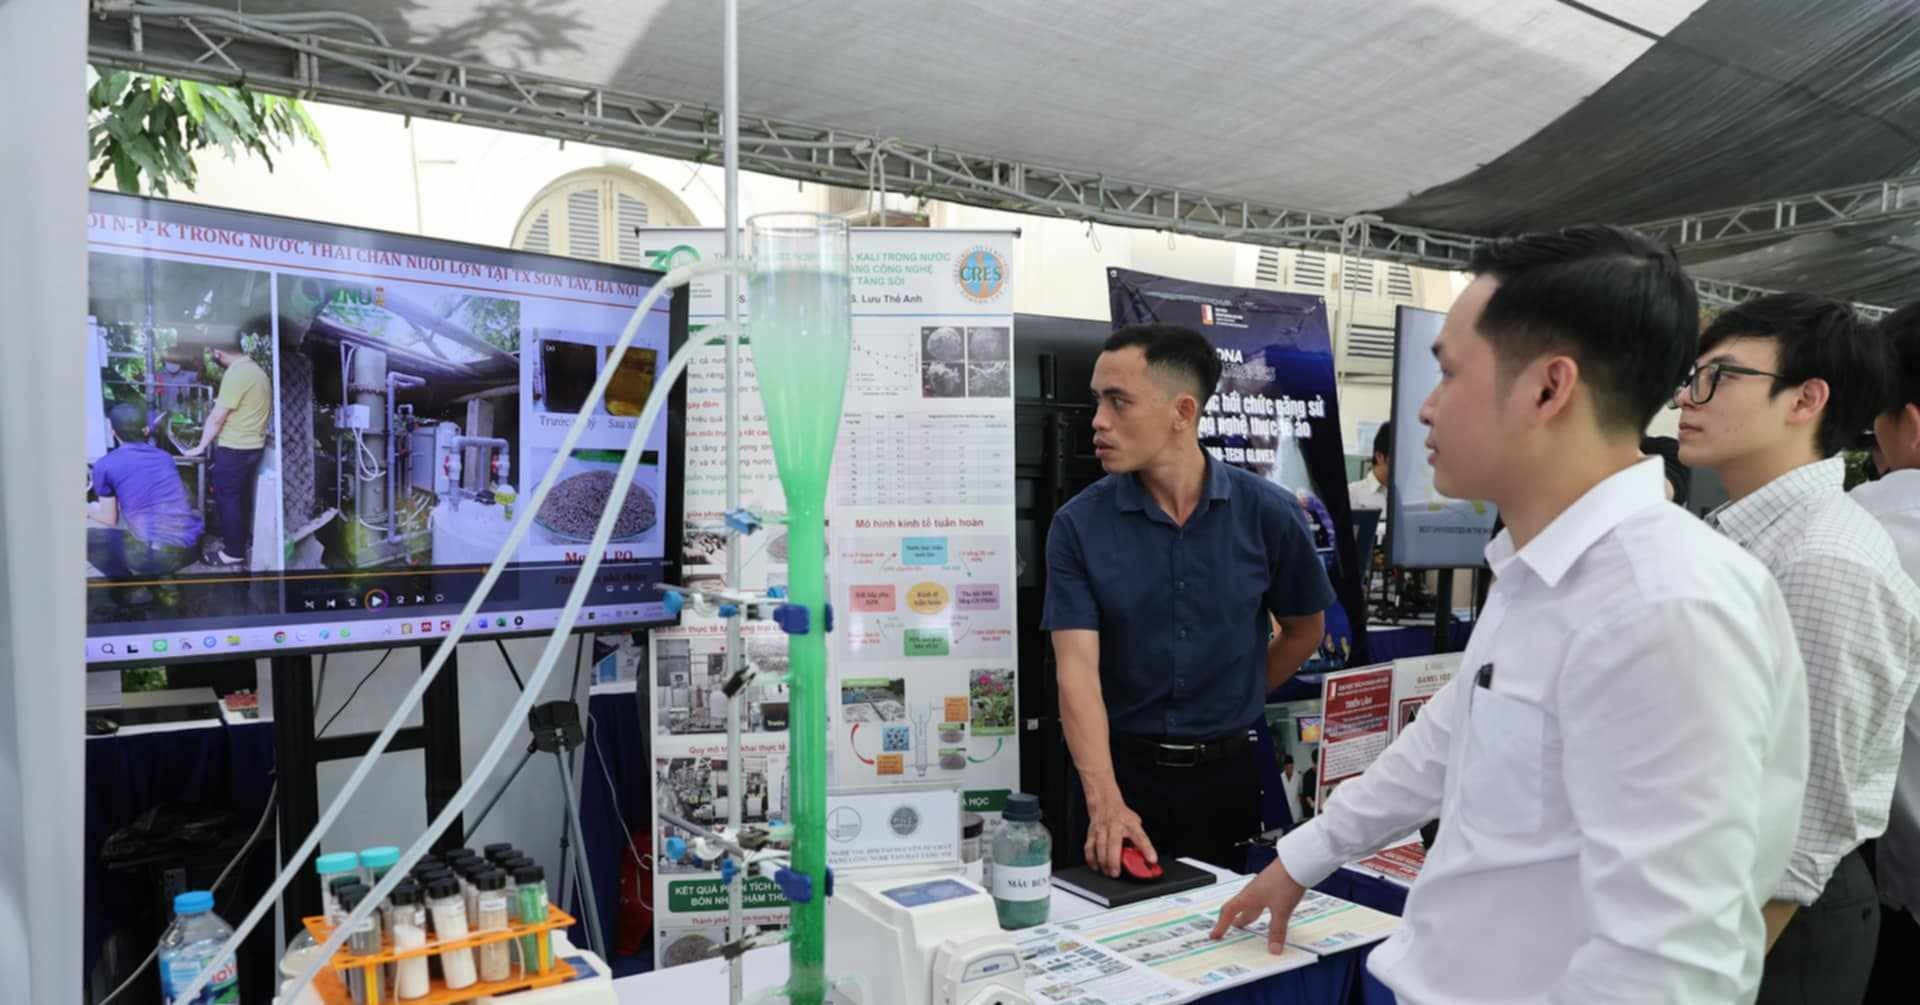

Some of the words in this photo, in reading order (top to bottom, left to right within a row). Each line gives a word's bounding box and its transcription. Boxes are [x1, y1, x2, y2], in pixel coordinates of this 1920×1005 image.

[113, 217, 169, 238] N-P-K
[178, 223, 243, 247] TRONG
[856, 252, 880, 263] KALI
[882, 252, 917, 263] TRONG
[960, 268, 1002, 284] CRES
[903, 294, 923, 305] Anh
[897, 517, 919, 529] kinh
[959, 516, 985, 528] hoàn
[968, 797, 990, 807] HỌC
